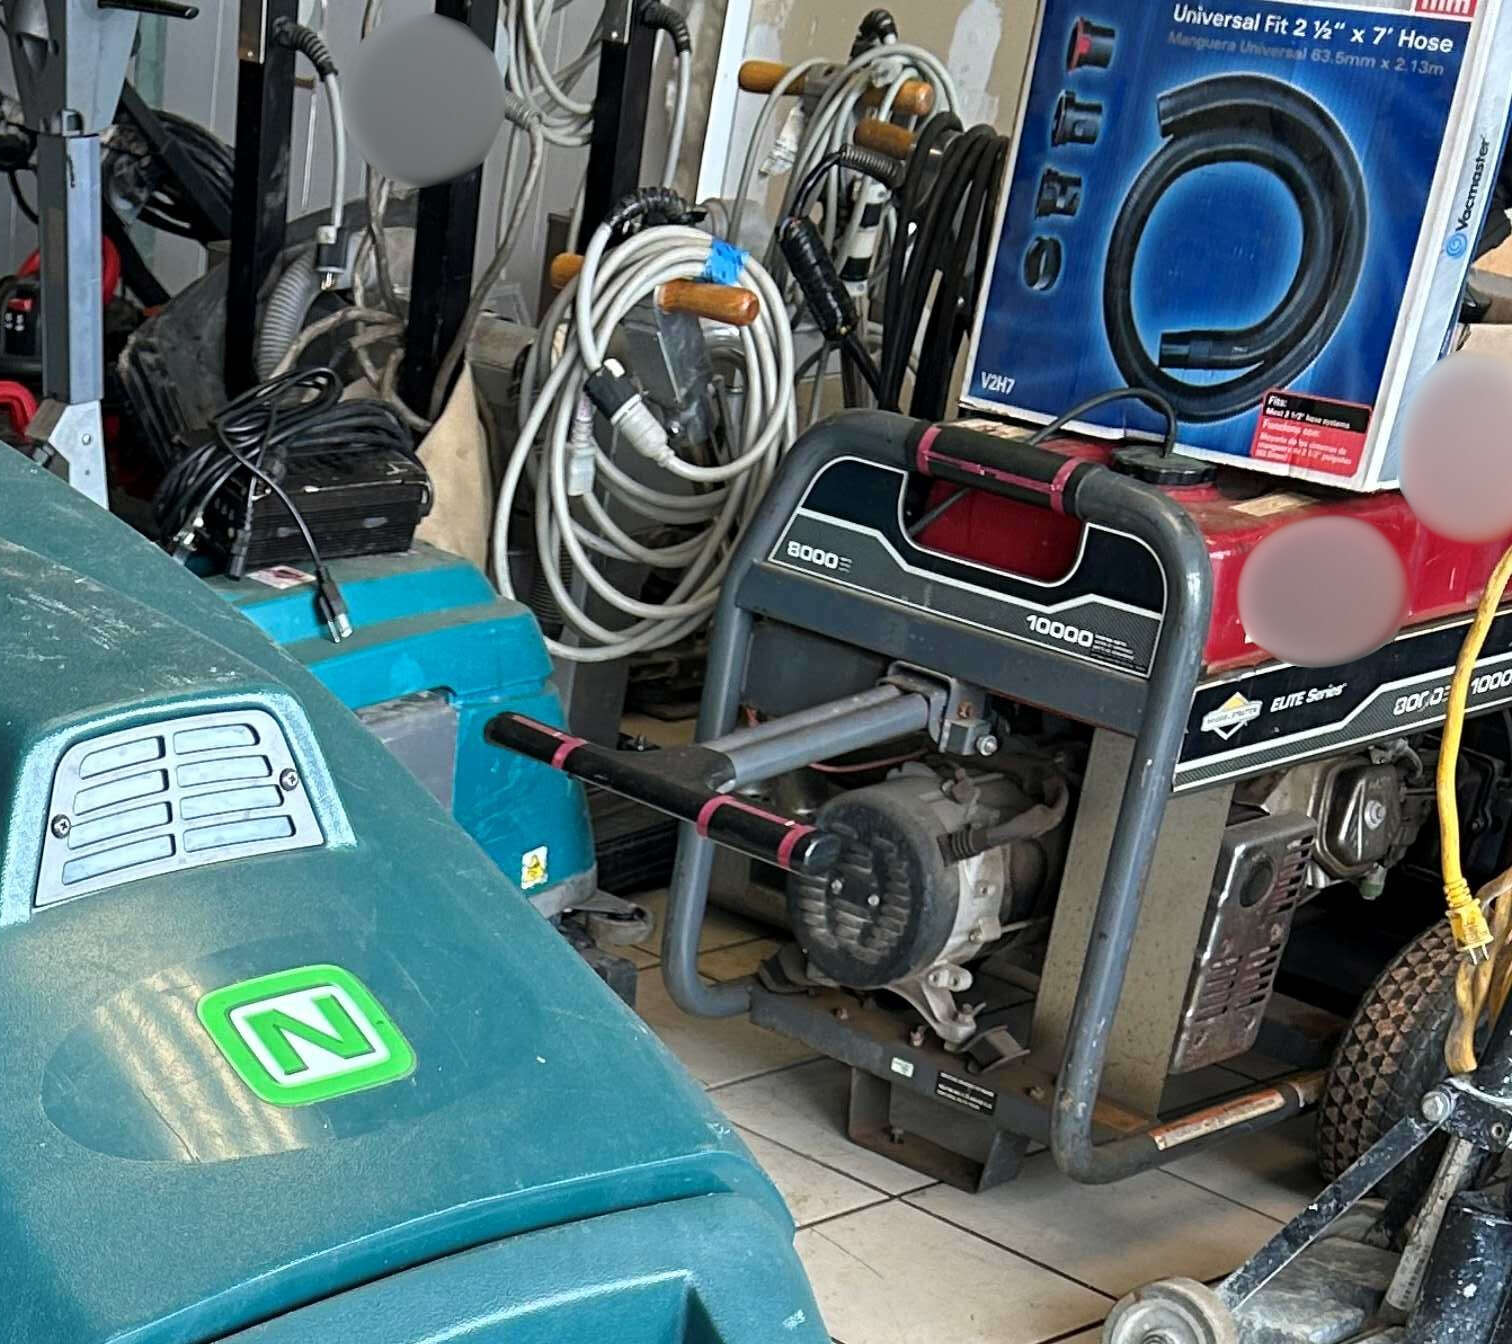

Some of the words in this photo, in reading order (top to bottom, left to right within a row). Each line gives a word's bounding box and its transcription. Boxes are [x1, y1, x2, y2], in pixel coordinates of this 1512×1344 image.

[1173, 3, 1261, 31] Universal
[1264, 14, 1289, 35] Fit
[1292, 18, 1308, 37] 2
[1350, 28, 1366, 43] x
[1398, 29, 1454, 53] Hose
[1168, 31, 1237, 52] Manguera
[1240, 40, 1308, 60] Universal
[1310, 48, 1377, 68] 63.5mm
[1380, 57, 1391, 69] x
[1394, 57, 1445, 76] 2.13m
[1455, 134, 1490, 232] Vacmaster
[981, 371, 1016, 395] V2H7
[787, 540, 839, 569] 8000
[1026, 614, 1094, 648] 10000
[1270, 691, 1306, 712] ELITE
[1306, 685, 1343, 703] Series
